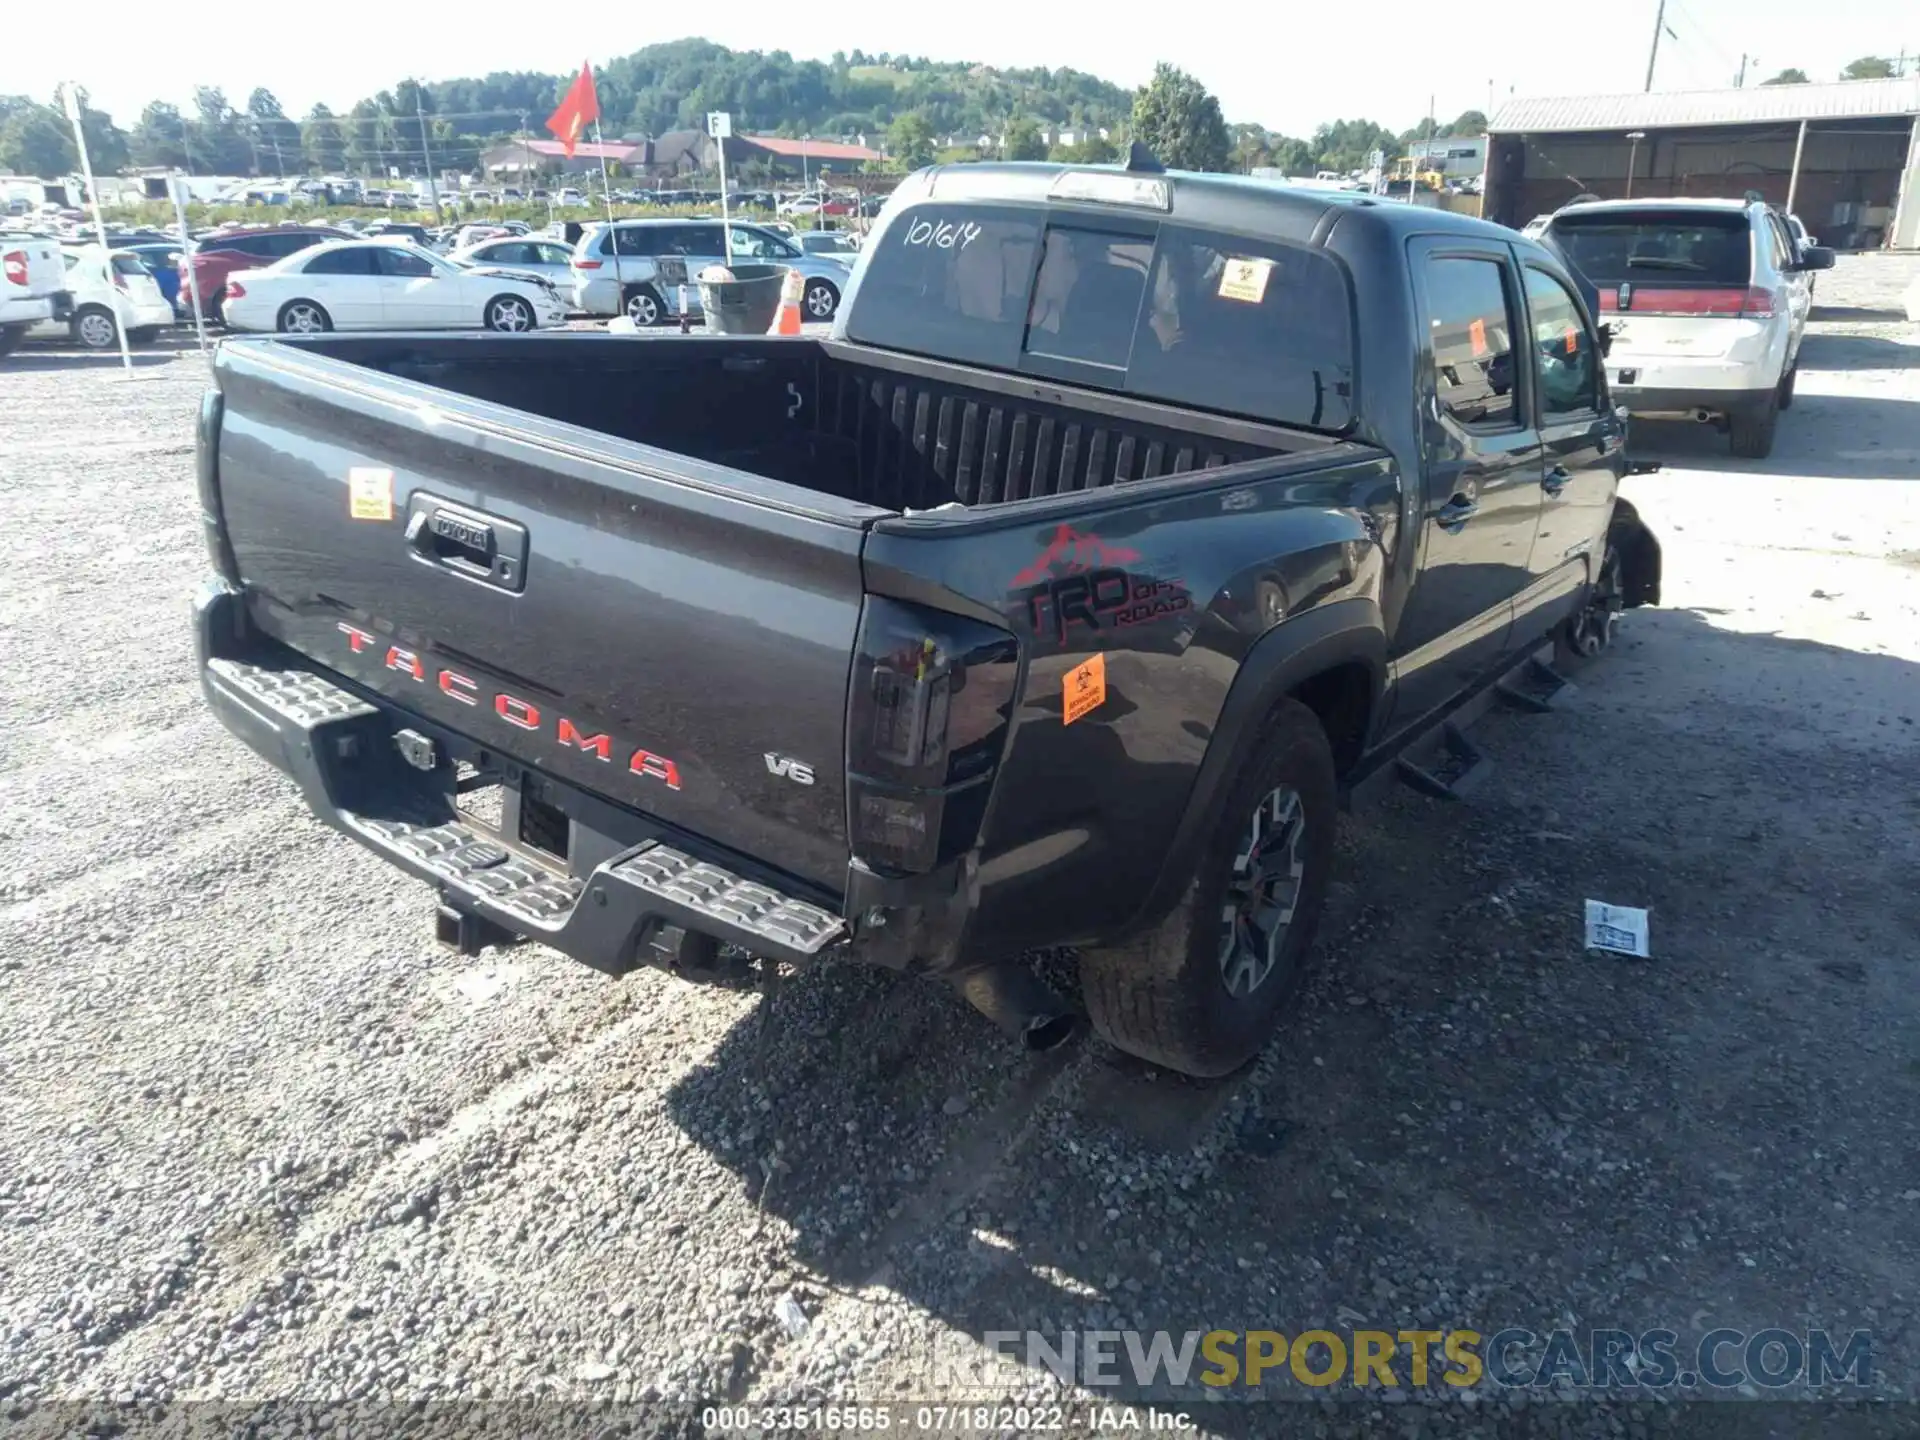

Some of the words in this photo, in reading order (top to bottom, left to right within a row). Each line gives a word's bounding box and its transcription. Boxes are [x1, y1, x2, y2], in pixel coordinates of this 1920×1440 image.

[432, 517, 488, 550] TOYOTA
[1007, 566, 1129, 647] TRD
[1114, 596, 1191, 627] ROAD
[336, 622, 682, 791] TACOMA
[763, 752, 815, 785] V6
